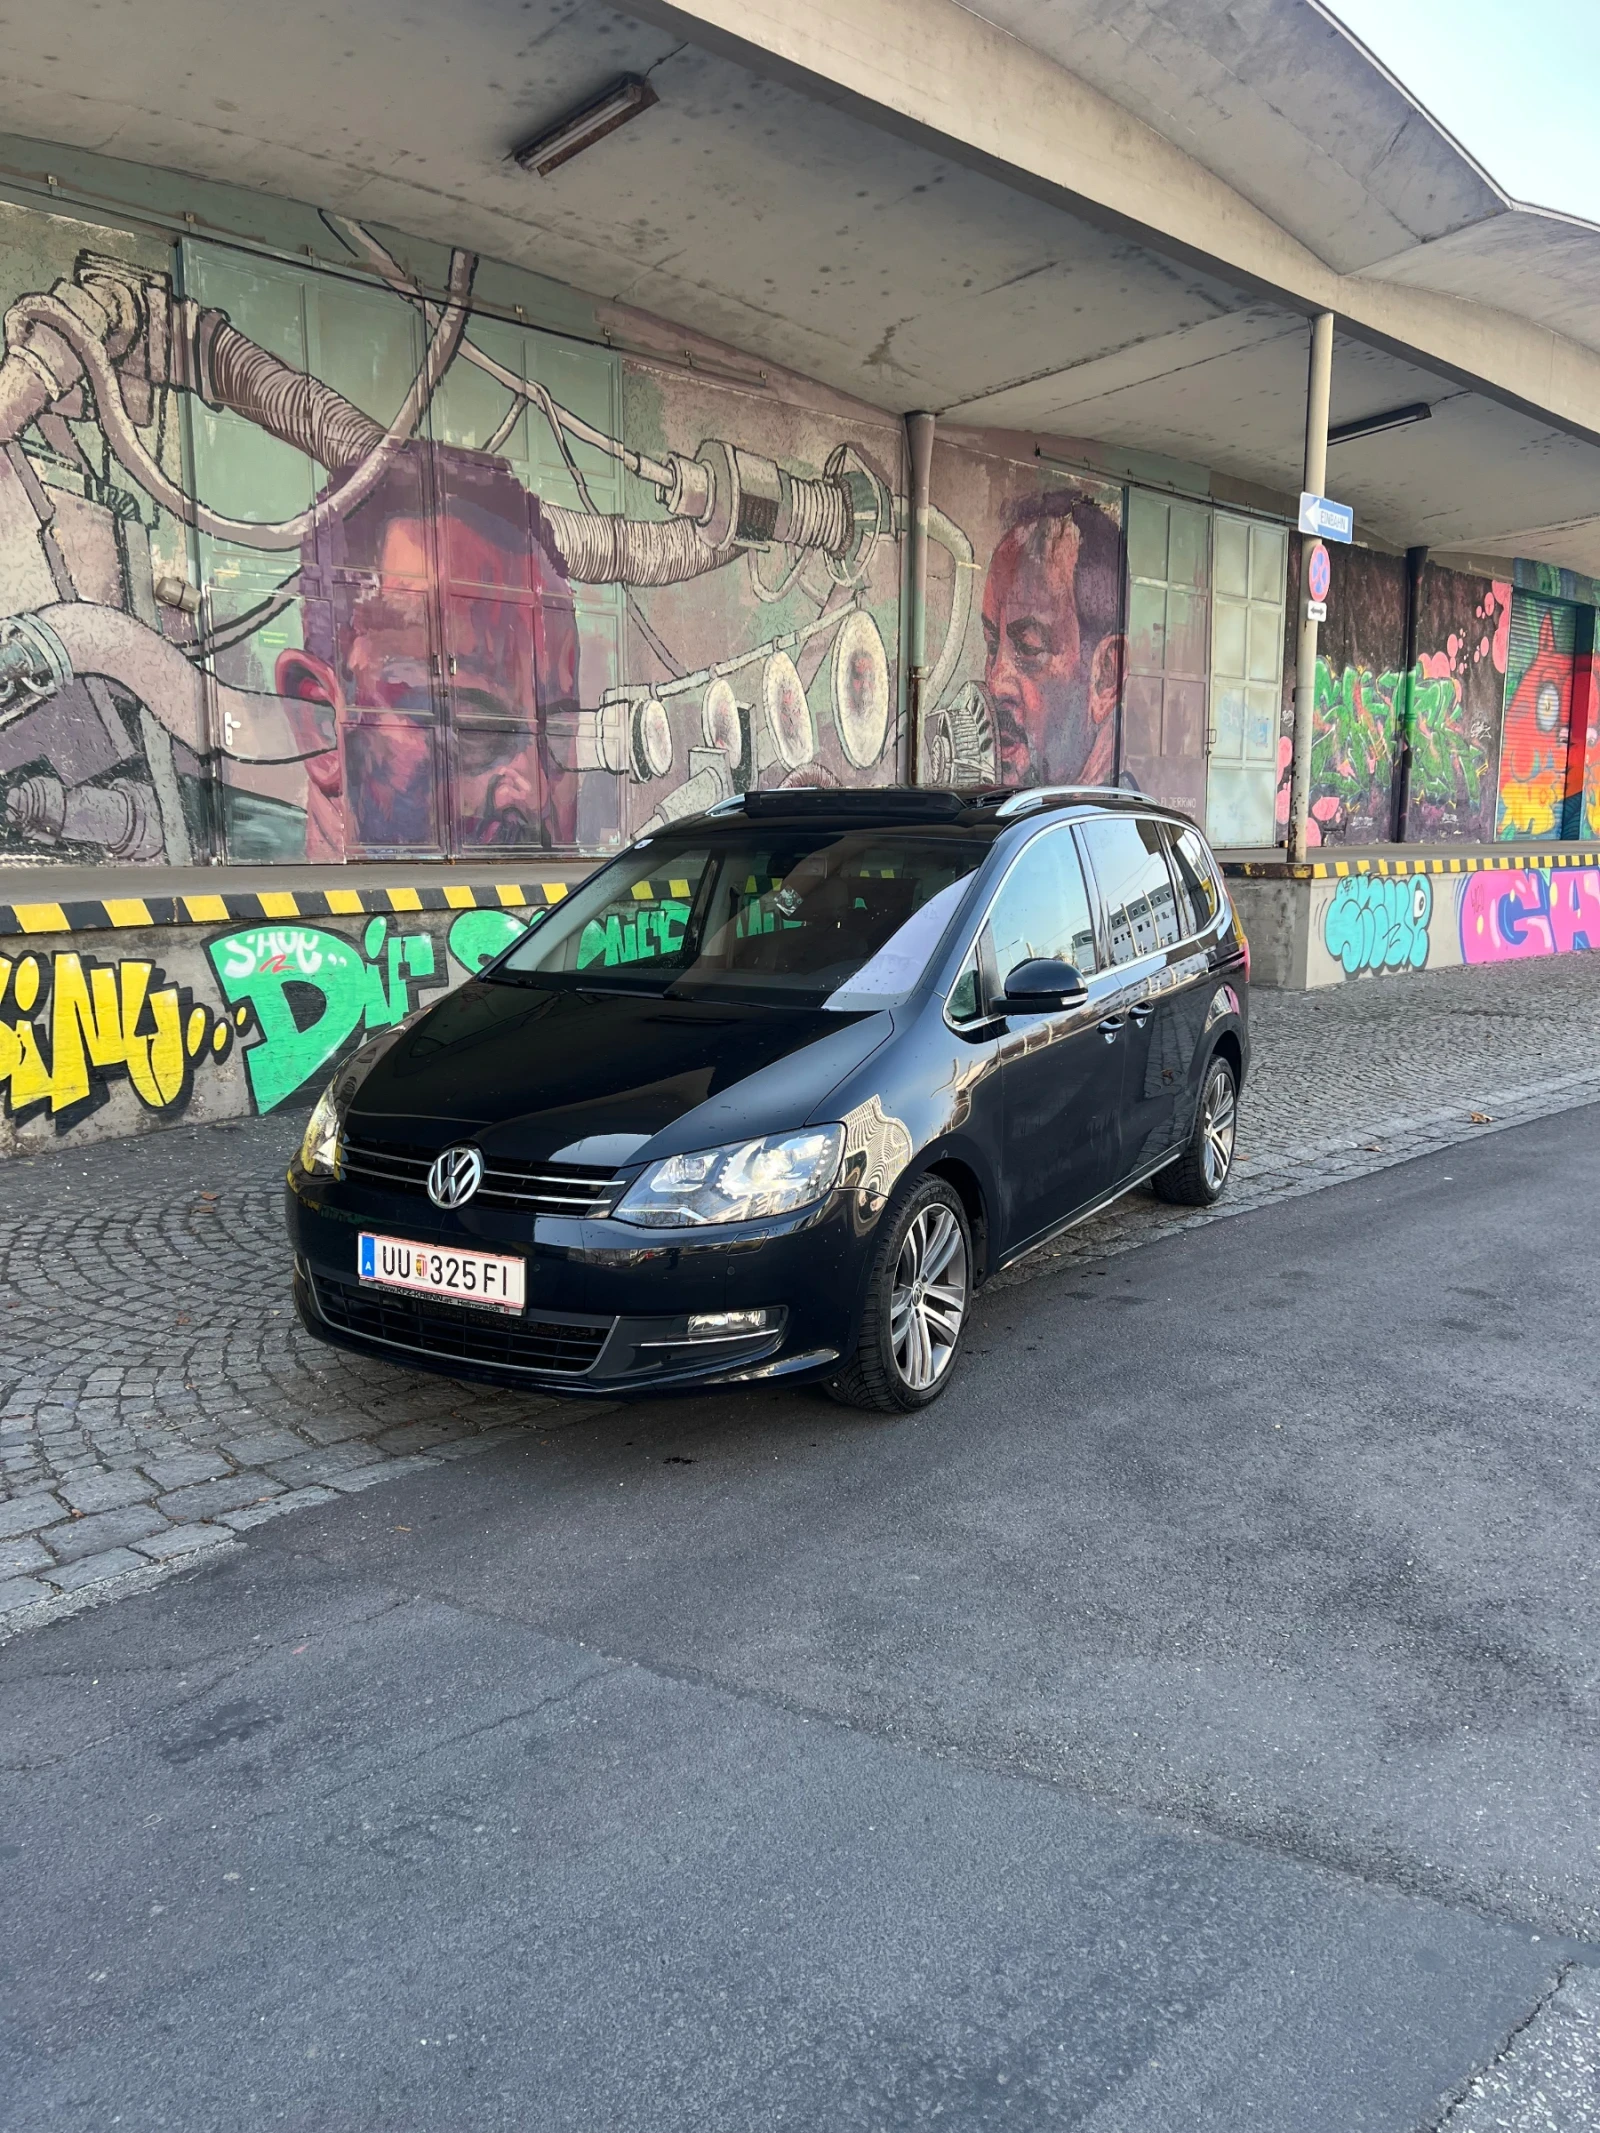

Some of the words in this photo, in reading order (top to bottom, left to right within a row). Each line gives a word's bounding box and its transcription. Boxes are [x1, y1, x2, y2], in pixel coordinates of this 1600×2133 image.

[1320, 510, 1346, 531] EINBAHN
[427, 1147, 482, 1209] VW
[364, 1260, 373, 1272] A
[382, 1245, 411, 1279] UU
